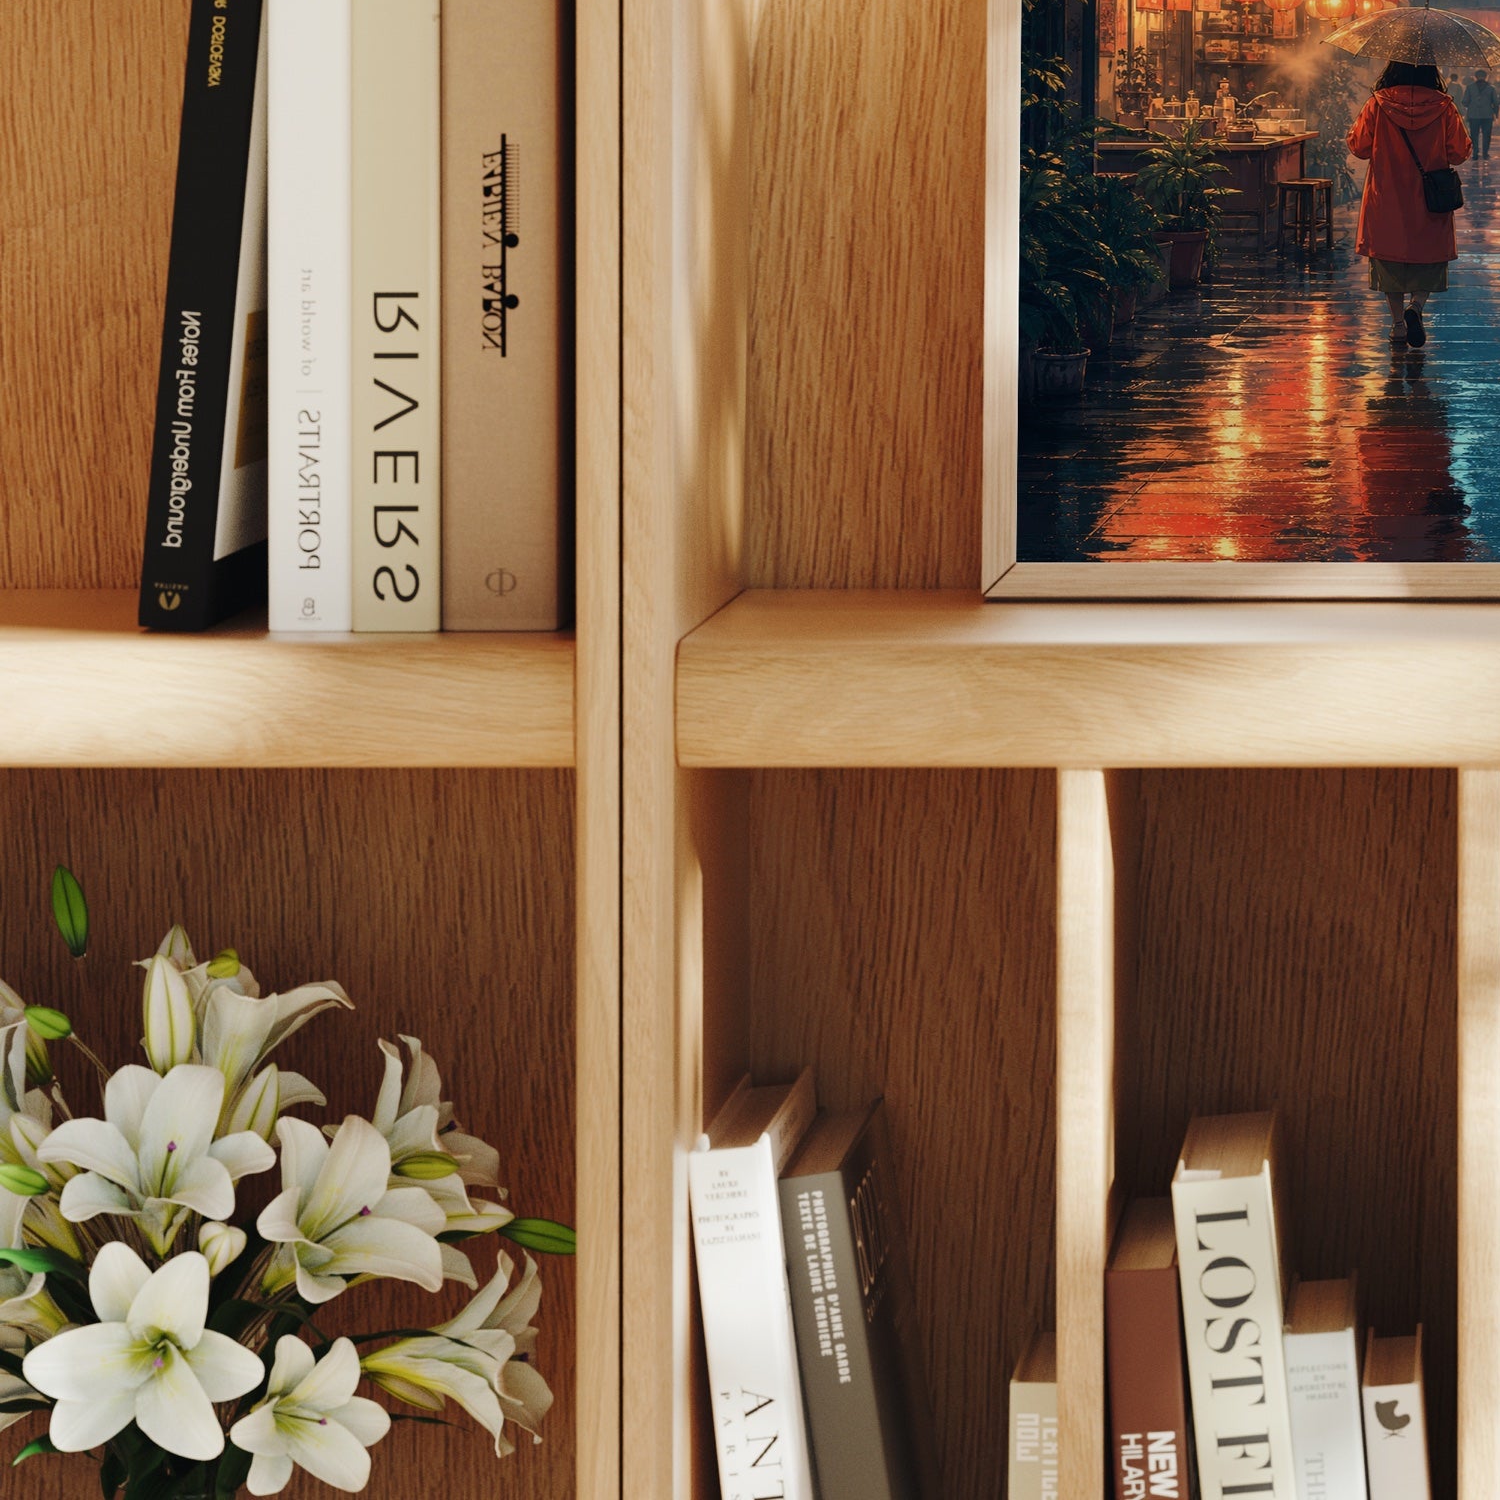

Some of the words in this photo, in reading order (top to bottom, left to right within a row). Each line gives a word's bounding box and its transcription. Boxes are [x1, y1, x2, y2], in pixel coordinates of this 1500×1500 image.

[797, 1192, 814, 1231] TEXTE
[804, 1234, 817, 1251] DE
[811, 1190, 838, 1290] PHOTOGRAPHIES
[806, 1255, 824, 1294] LAURE
[827, 1293, 845, 1340] D'ANNE
[1193, 1203, 1267, 1406] LOST
[835, 1343, 852, 1384] GARDE
[1147, 1431, 1179, 1498] NEW
